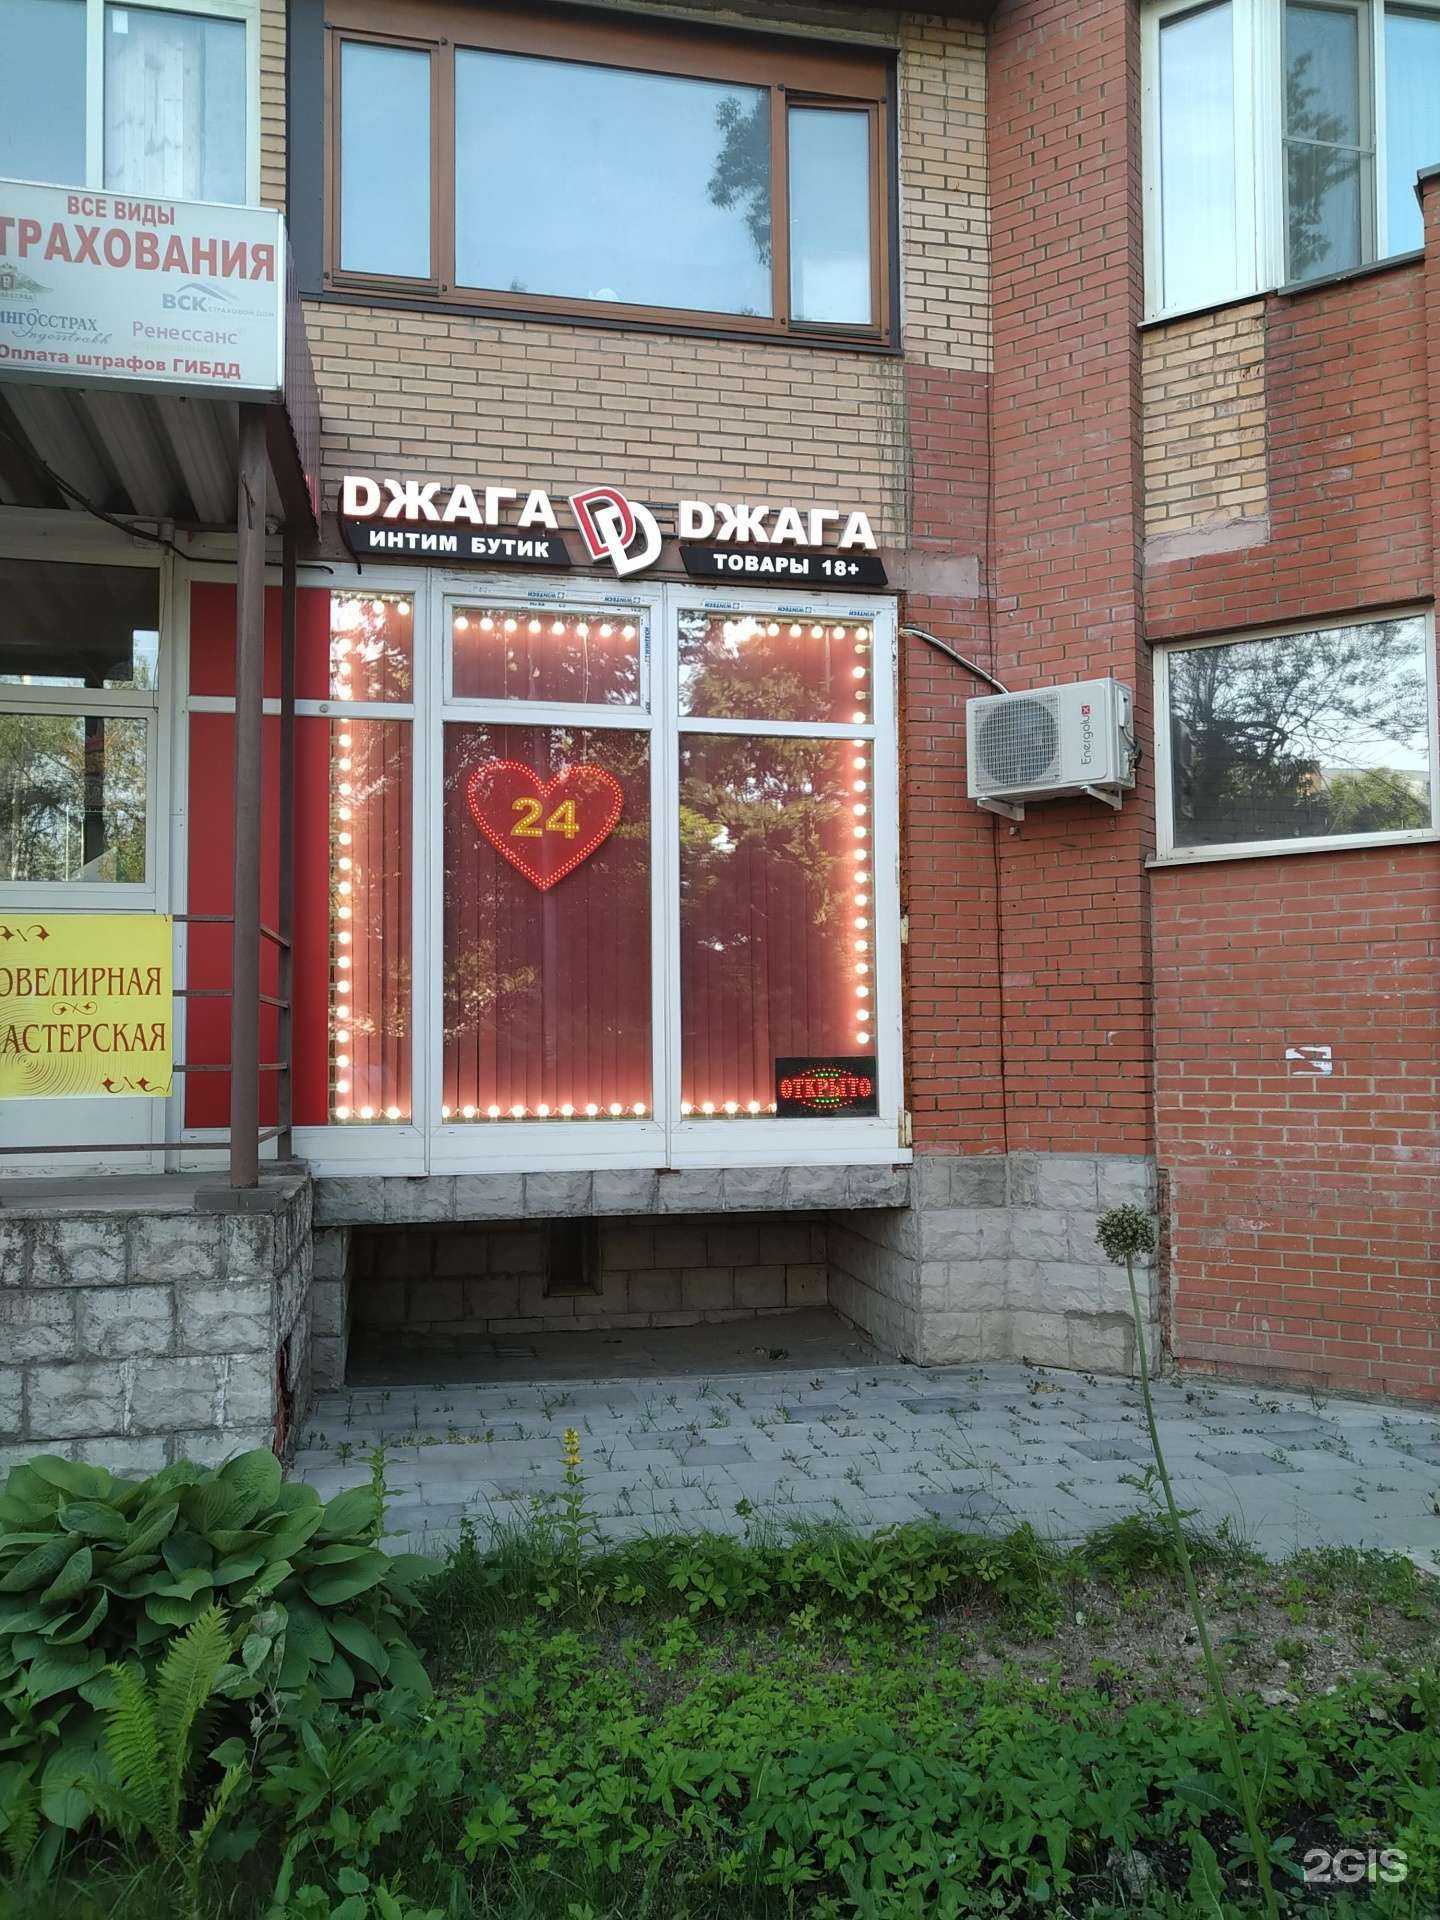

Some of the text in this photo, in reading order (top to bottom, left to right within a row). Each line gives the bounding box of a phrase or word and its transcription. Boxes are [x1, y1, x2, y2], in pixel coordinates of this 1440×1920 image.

[67, 195, 175, 227] ВСЕ ВИДЫ
[162, 293, 208, 313] ВСК
[132, 320, 238, 345] Ренессанс
[0, 344, 241, 379] Оплата штрафов ГИБДД
[369, 530, 549, 559] ИНТИМ БУТИК
[713, 553, 860, 577] ТОВАРЫ 18+
[510, 797, 580, 840] 24
[781, 1077, 871, 1099] ОТКРЫТО
